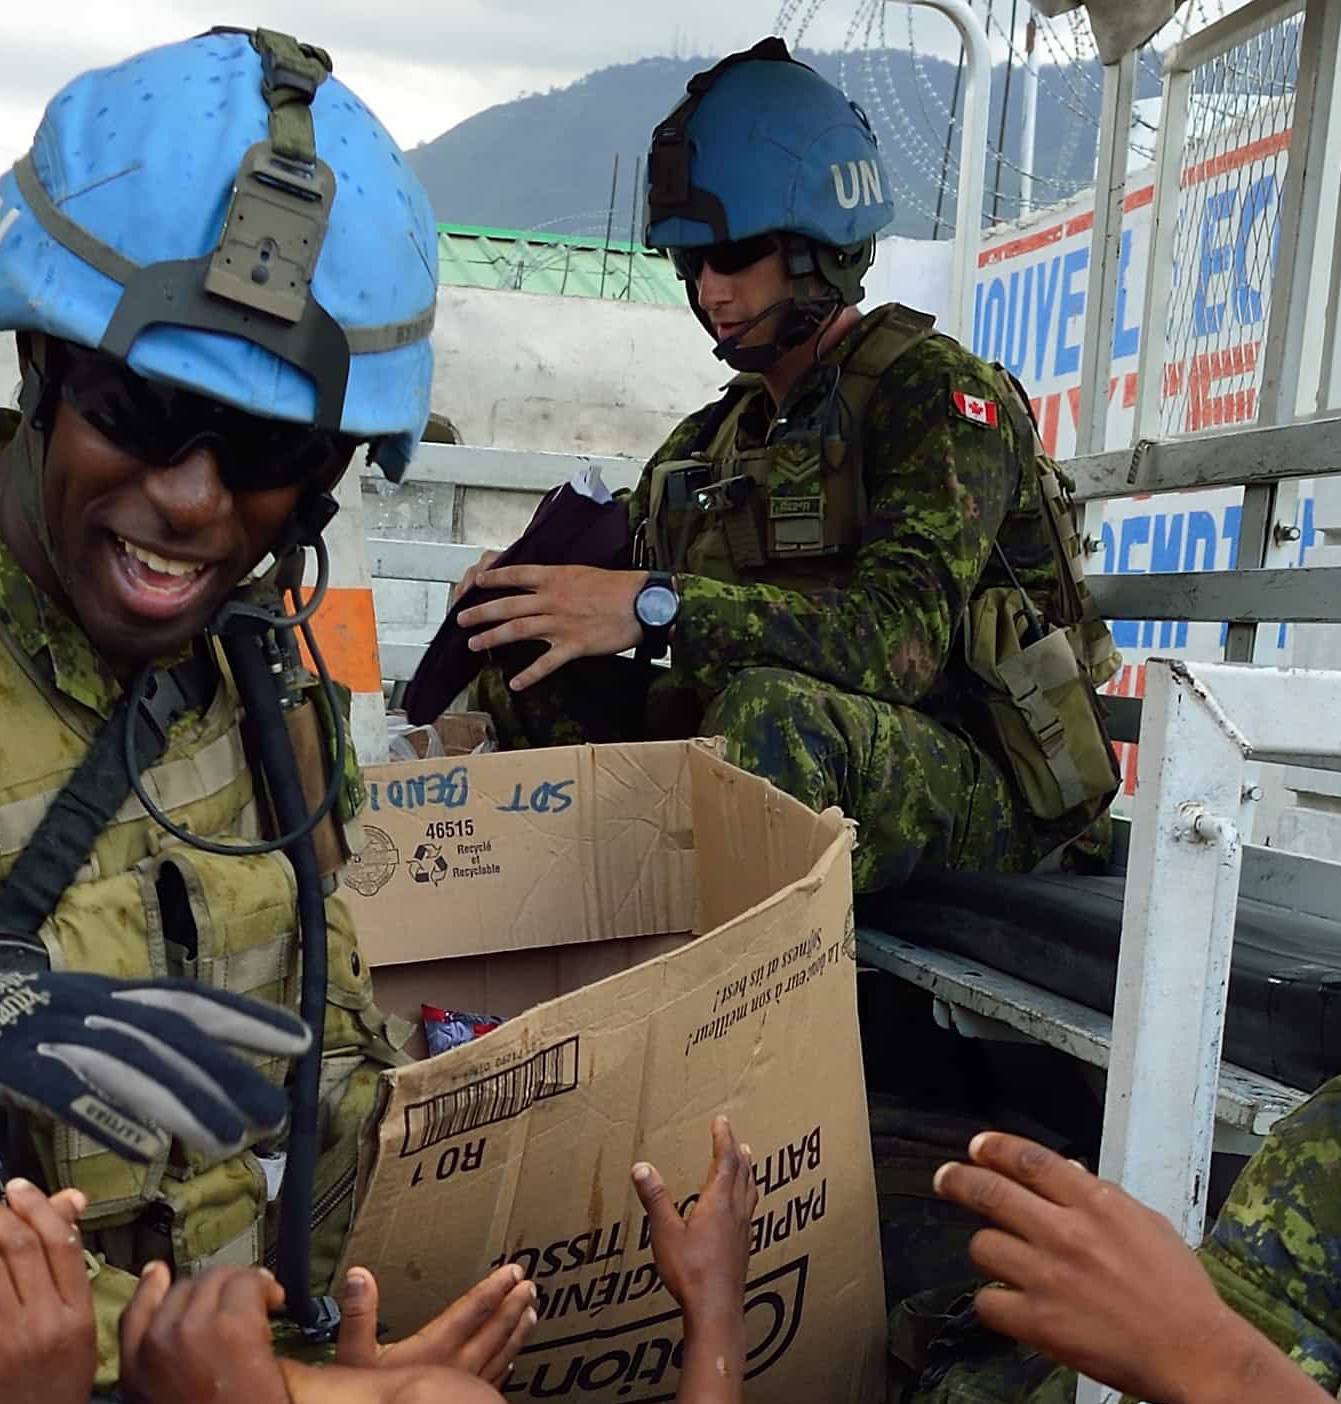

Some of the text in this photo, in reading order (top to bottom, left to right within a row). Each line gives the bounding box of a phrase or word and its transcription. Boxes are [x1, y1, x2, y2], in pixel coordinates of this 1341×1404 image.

[831, 159, 884, 209] UN
[426, 818, 475, 840] 46515
[457, 840, 493, 855] Recyclé
[452, 862, 501, 879] Recyclable
[471, 856, 481, 865] et
[826, 942, 840, 964] La
[749, 965, 765, 987] its
[766, 957, 779, 978] at
[751, 988, 772, 1014] son
[774, 982, 784, 1004] à
[748, 1178, 828, 1257] PAPIE
[489, 1221, 625, 1281] TISSU
